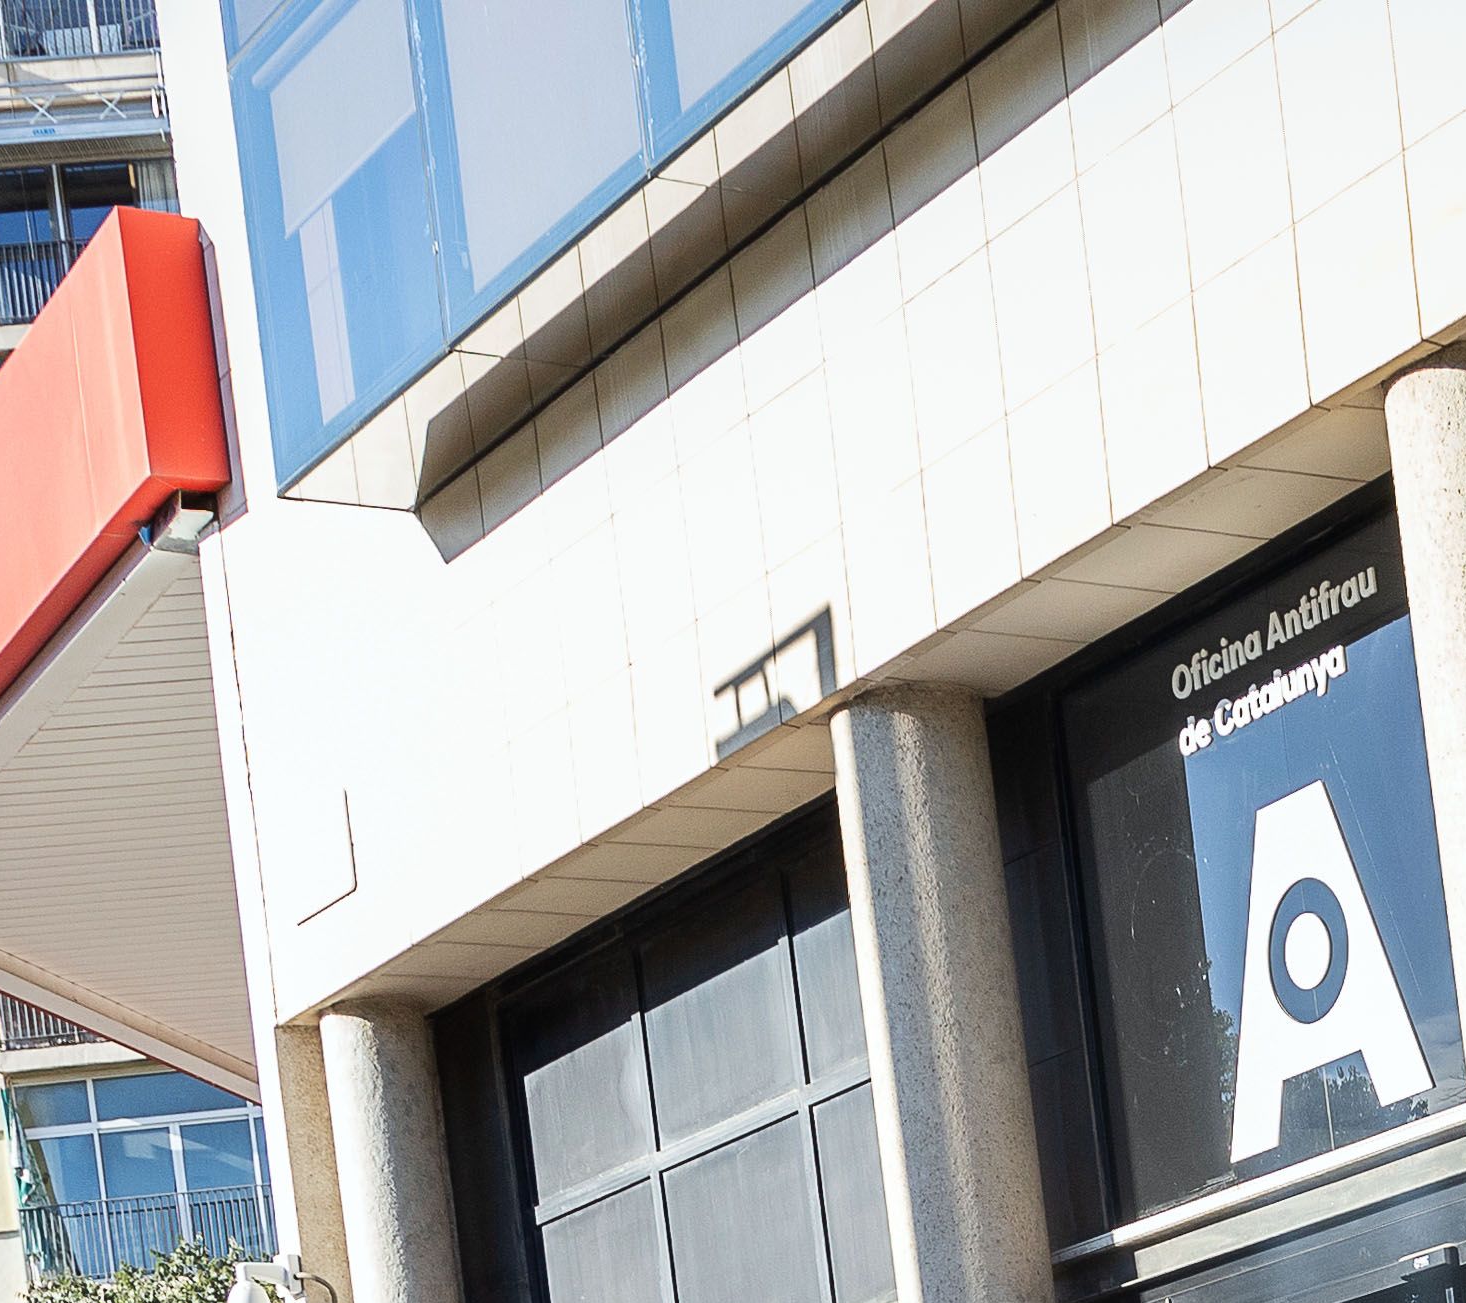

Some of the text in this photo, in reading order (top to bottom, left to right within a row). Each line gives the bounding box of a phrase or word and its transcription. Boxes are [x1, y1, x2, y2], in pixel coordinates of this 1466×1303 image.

[1171, 566, 1378, 700] Oficina Antifrau
[1179, 644, 1348, 757] de Catalunya
